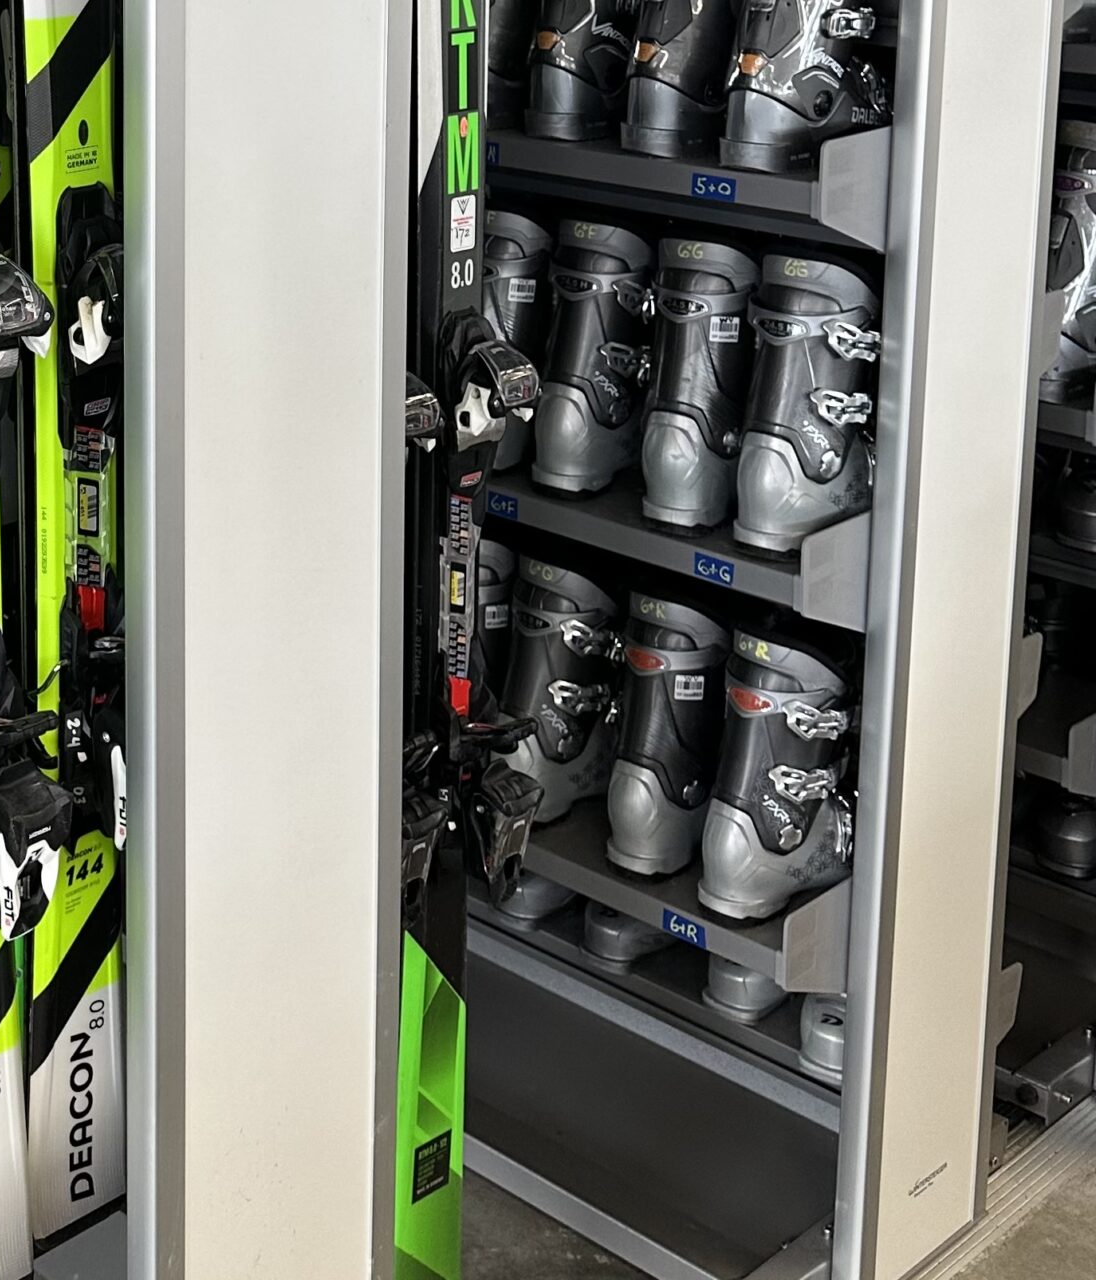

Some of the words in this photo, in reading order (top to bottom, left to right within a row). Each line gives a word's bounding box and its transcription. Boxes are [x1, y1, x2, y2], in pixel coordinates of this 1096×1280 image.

[67, 152, 83, 162] MADE
[84, 151, 92, 159] IN
[67, 157, 99, 169] GERMANY
[451, 259, 474, 288] 8.0
[803, 421, 831, 450] FXR
[490, 496, 515, 514] 6+F
[698, 559, 731, 582] 6+G
[738, 640, 771, 661] 6+R
[67, 717, 81, 748] 2-4
[764, 796, 791, 824] FXR
[66, 852, 104, 887] 144
[3, 886, 15, 922] FDT
[69, 1032, 95, 1202] DEACON
[89, 999, 105, 1030] 8.0
